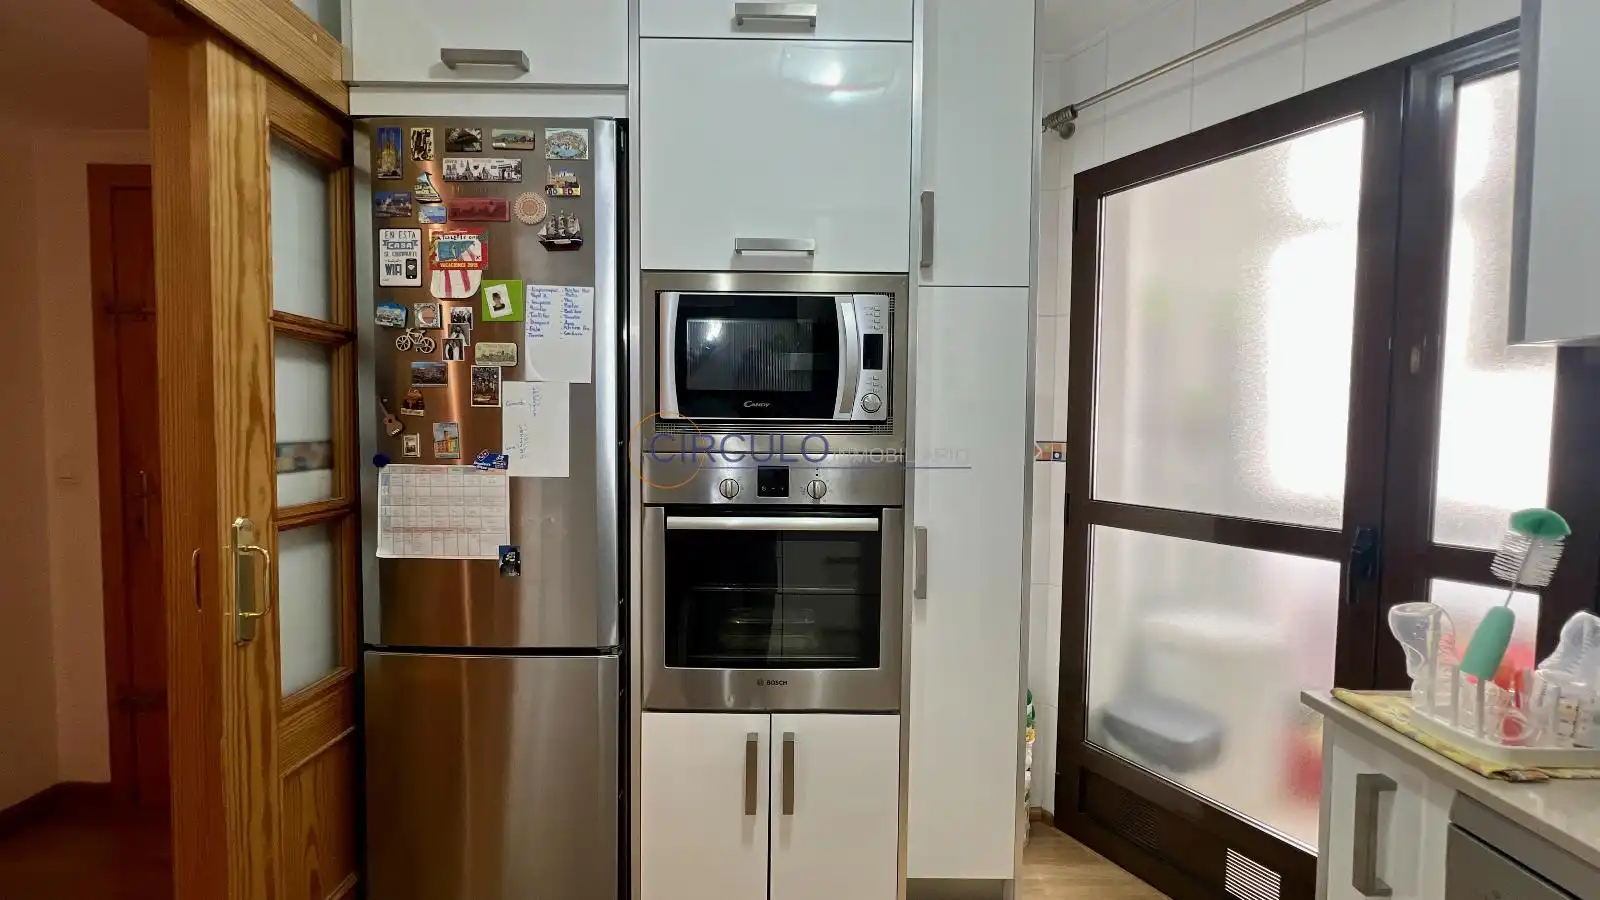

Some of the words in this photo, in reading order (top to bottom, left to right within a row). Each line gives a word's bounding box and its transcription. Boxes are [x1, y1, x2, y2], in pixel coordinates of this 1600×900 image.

[384, 231, 395, 239] EN
[398, 231, 416, 239] ESTA
[743, 400, 771, 408] CANDY
